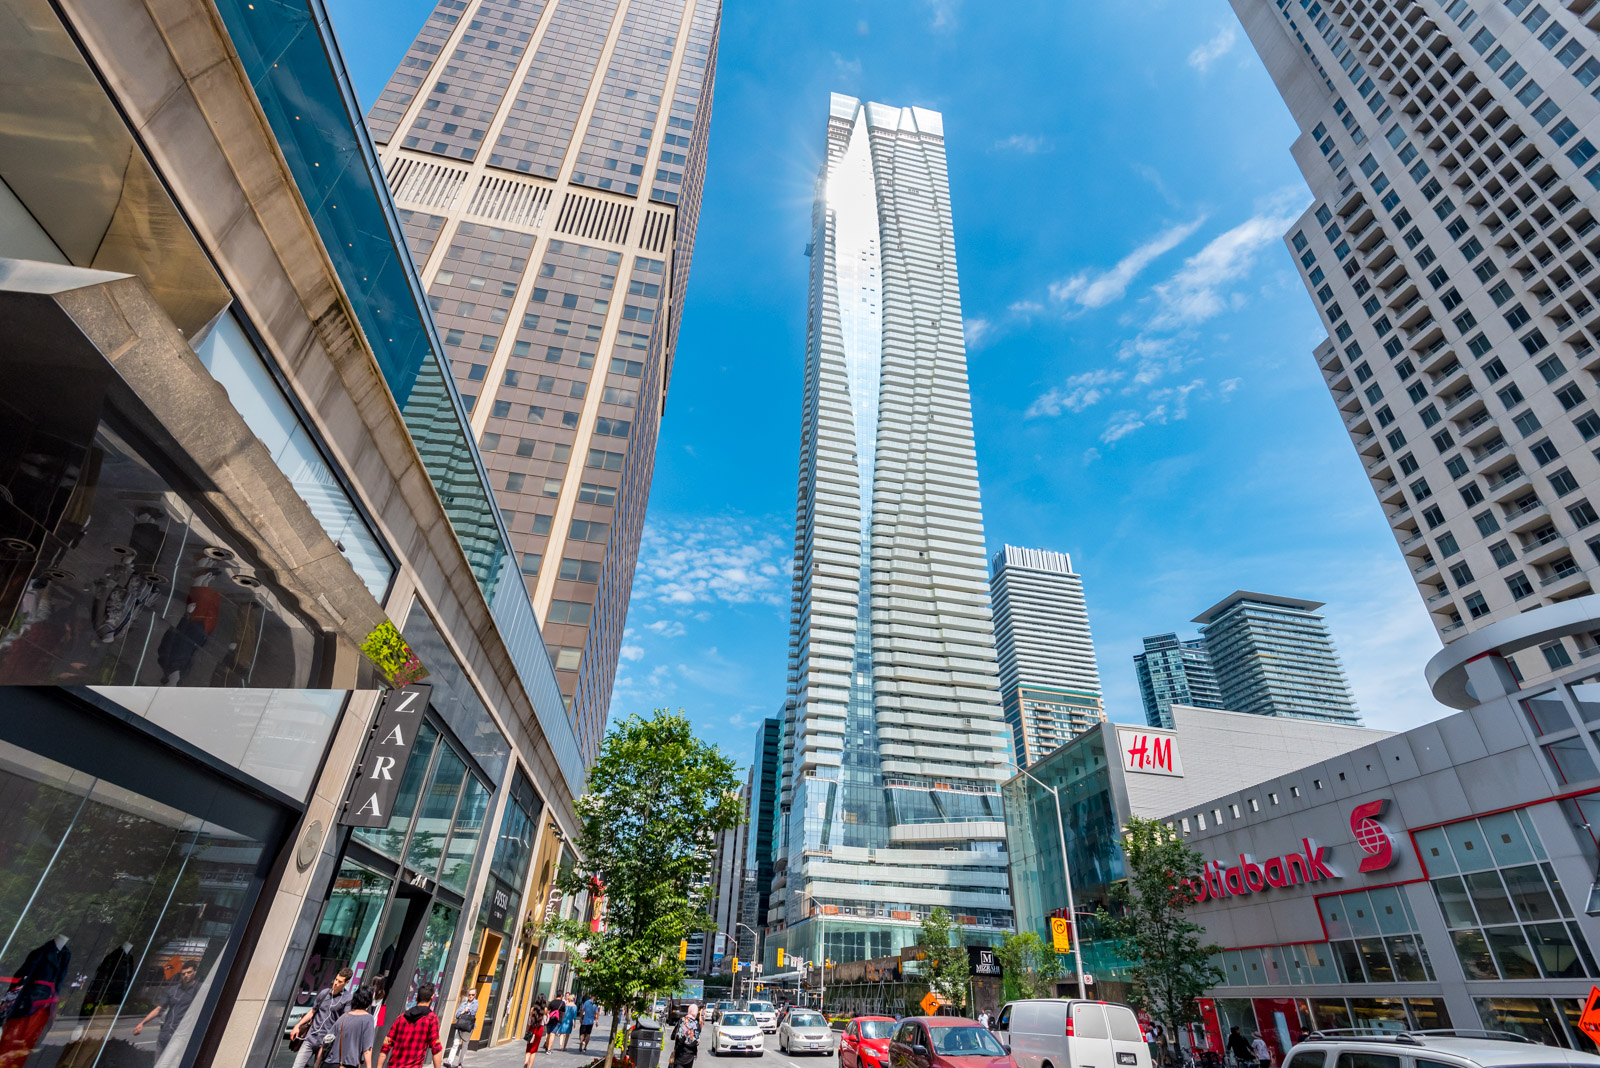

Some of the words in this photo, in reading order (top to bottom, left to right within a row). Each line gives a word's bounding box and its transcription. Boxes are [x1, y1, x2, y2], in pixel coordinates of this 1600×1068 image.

[356, 690, 420, 817] ZARA
[1127, 734, 1173, 773] H&M
[493, 889, 509, 911] FOSSIL
[297, 954, 366, 1005] SAE
